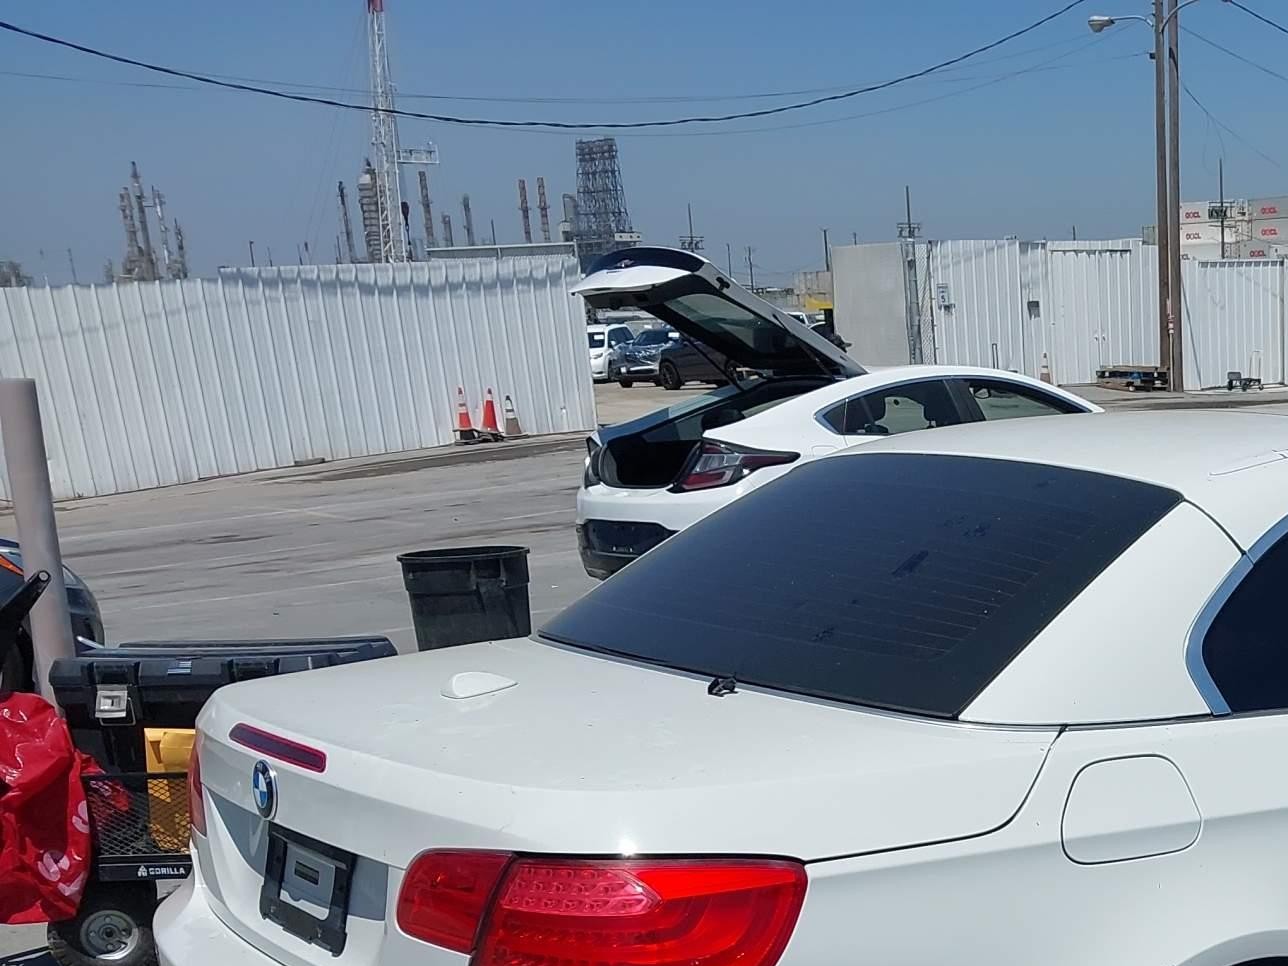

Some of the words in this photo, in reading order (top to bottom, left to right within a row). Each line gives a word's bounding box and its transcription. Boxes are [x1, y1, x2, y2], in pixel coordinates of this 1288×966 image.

[1185, 211, 1201, 219] OOCL
[1261, 207, 1277, 215] OOCL
[1250, 250, 1266, 258] OOCL
[149, 867, 185, 875] GORILLA
